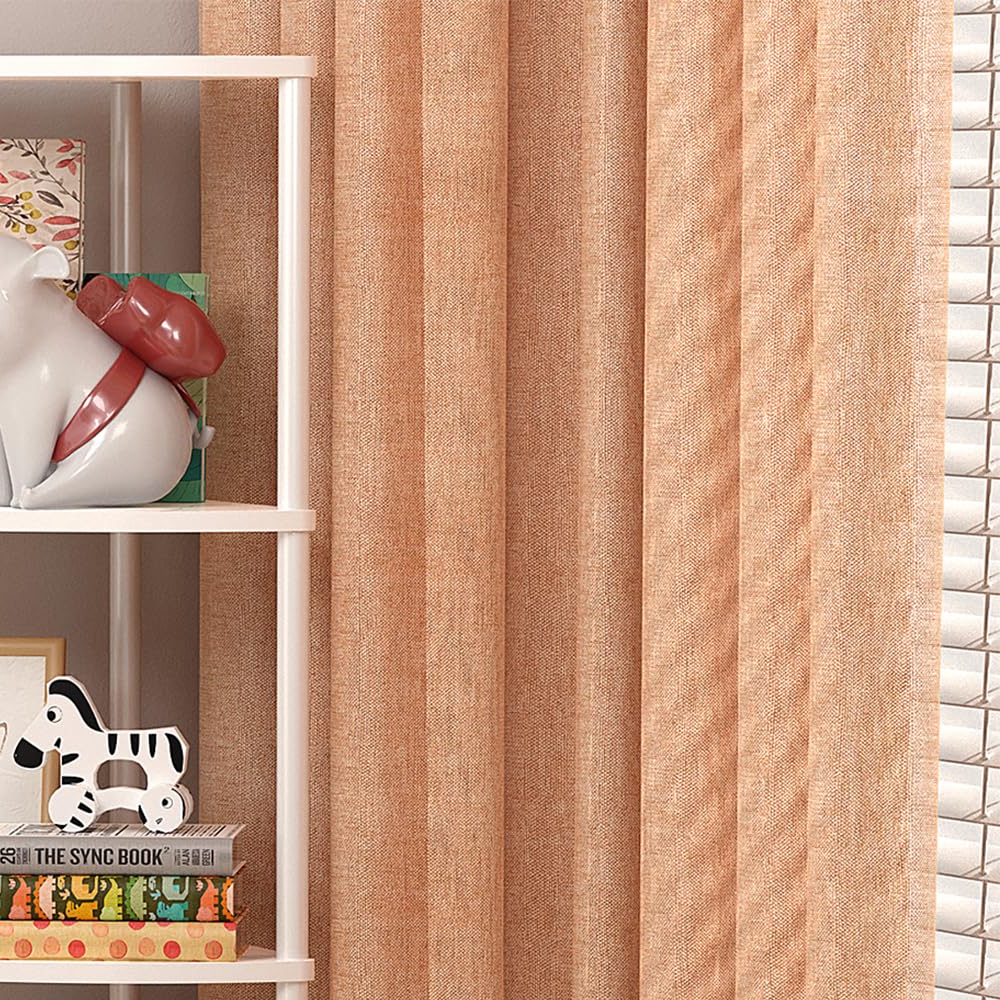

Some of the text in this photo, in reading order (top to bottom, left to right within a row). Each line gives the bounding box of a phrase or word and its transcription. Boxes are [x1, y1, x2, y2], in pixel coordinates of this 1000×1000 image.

[0, 847, 16, 865] 26
[34, 848, 66, 866] THE
[70, 847, 114, 866] SYNC
